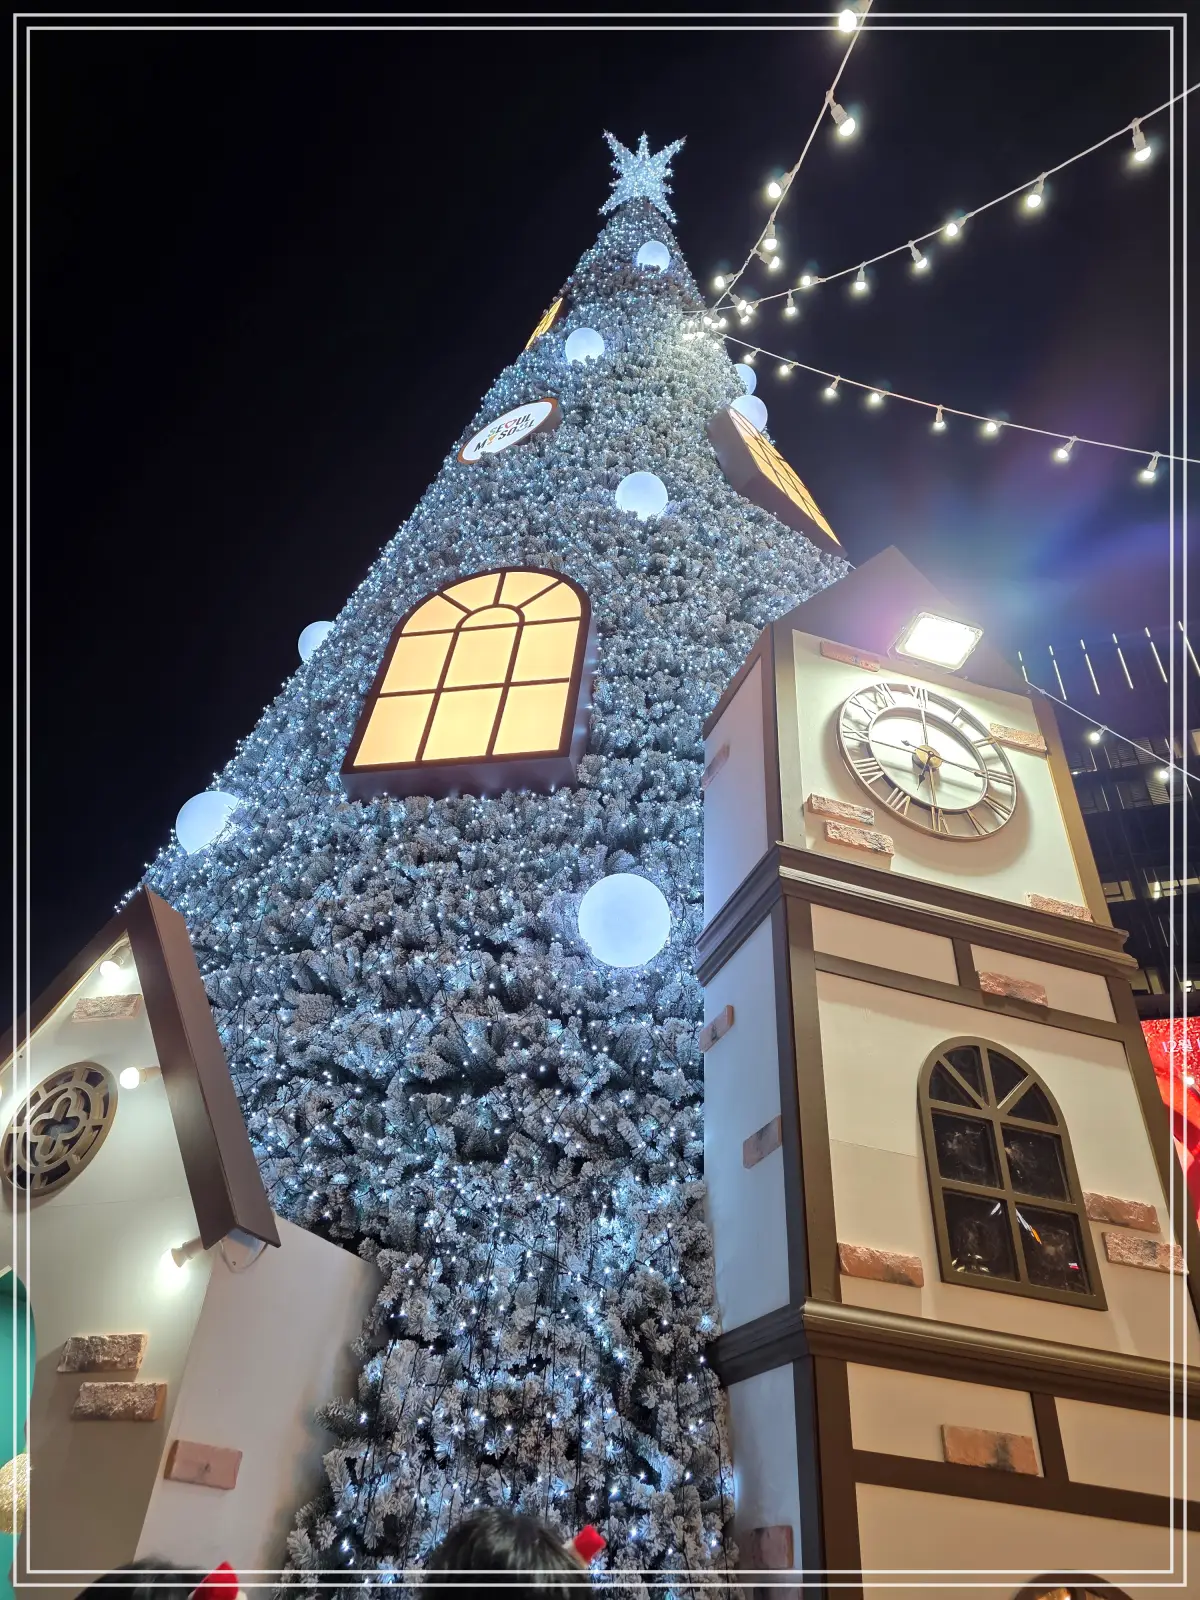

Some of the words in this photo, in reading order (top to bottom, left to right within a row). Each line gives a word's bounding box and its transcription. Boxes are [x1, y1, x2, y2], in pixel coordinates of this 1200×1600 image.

[474, 434, 497, 453] MY
[498, 419, 535, 440] SOUL
[488, 413, 532, 437] SEOUL
